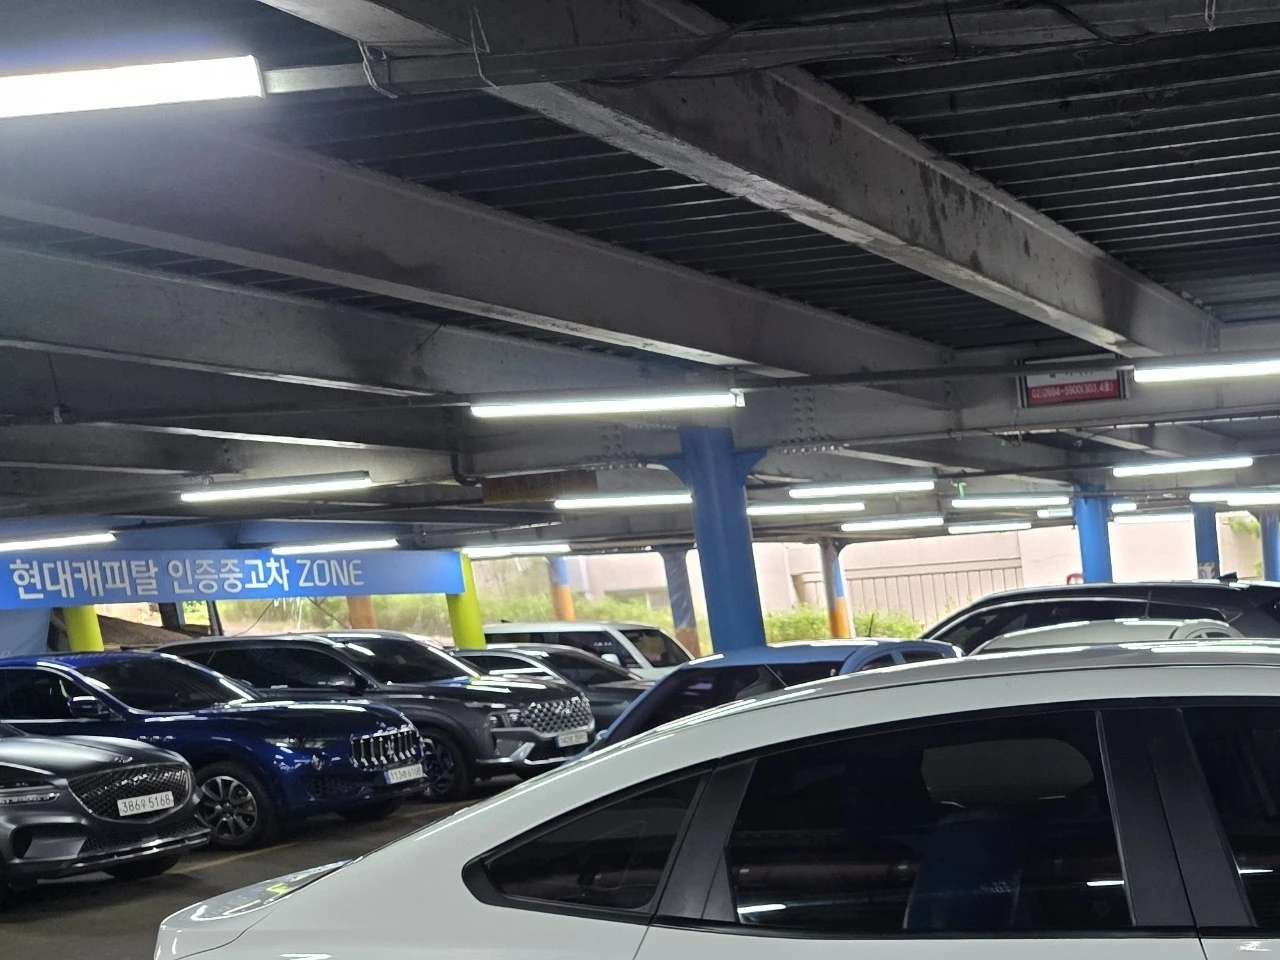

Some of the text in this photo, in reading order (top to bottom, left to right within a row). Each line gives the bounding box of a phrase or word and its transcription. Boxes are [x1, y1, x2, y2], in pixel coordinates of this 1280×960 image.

[9, 557, 365, 600] 현대캐피탈 인증중고차 ZONE
[148, 794, 170, 808] 5168
